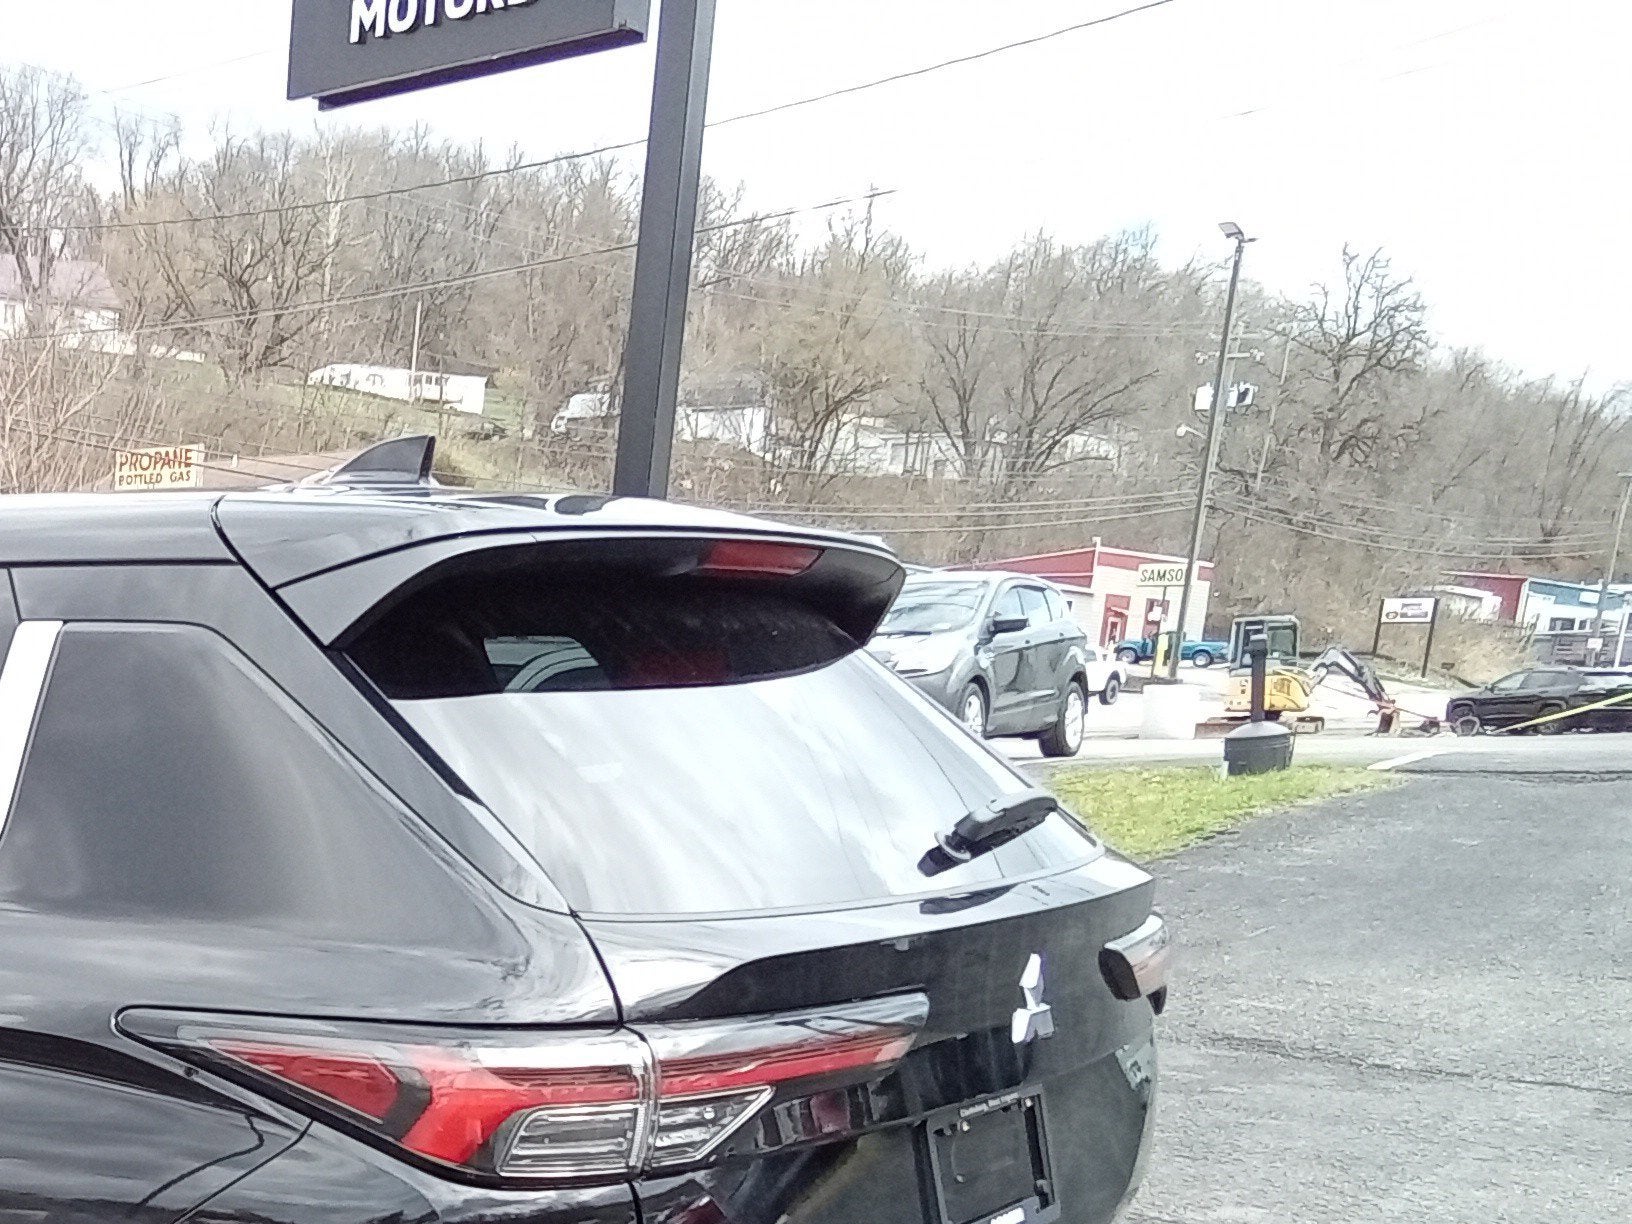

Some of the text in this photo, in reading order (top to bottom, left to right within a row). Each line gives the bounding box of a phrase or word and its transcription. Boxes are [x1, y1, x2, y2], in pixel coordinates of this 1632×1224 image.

[119, 447, 193, 472] PROPANE
[119, 470, 191, 487] BOTTLED GAS
